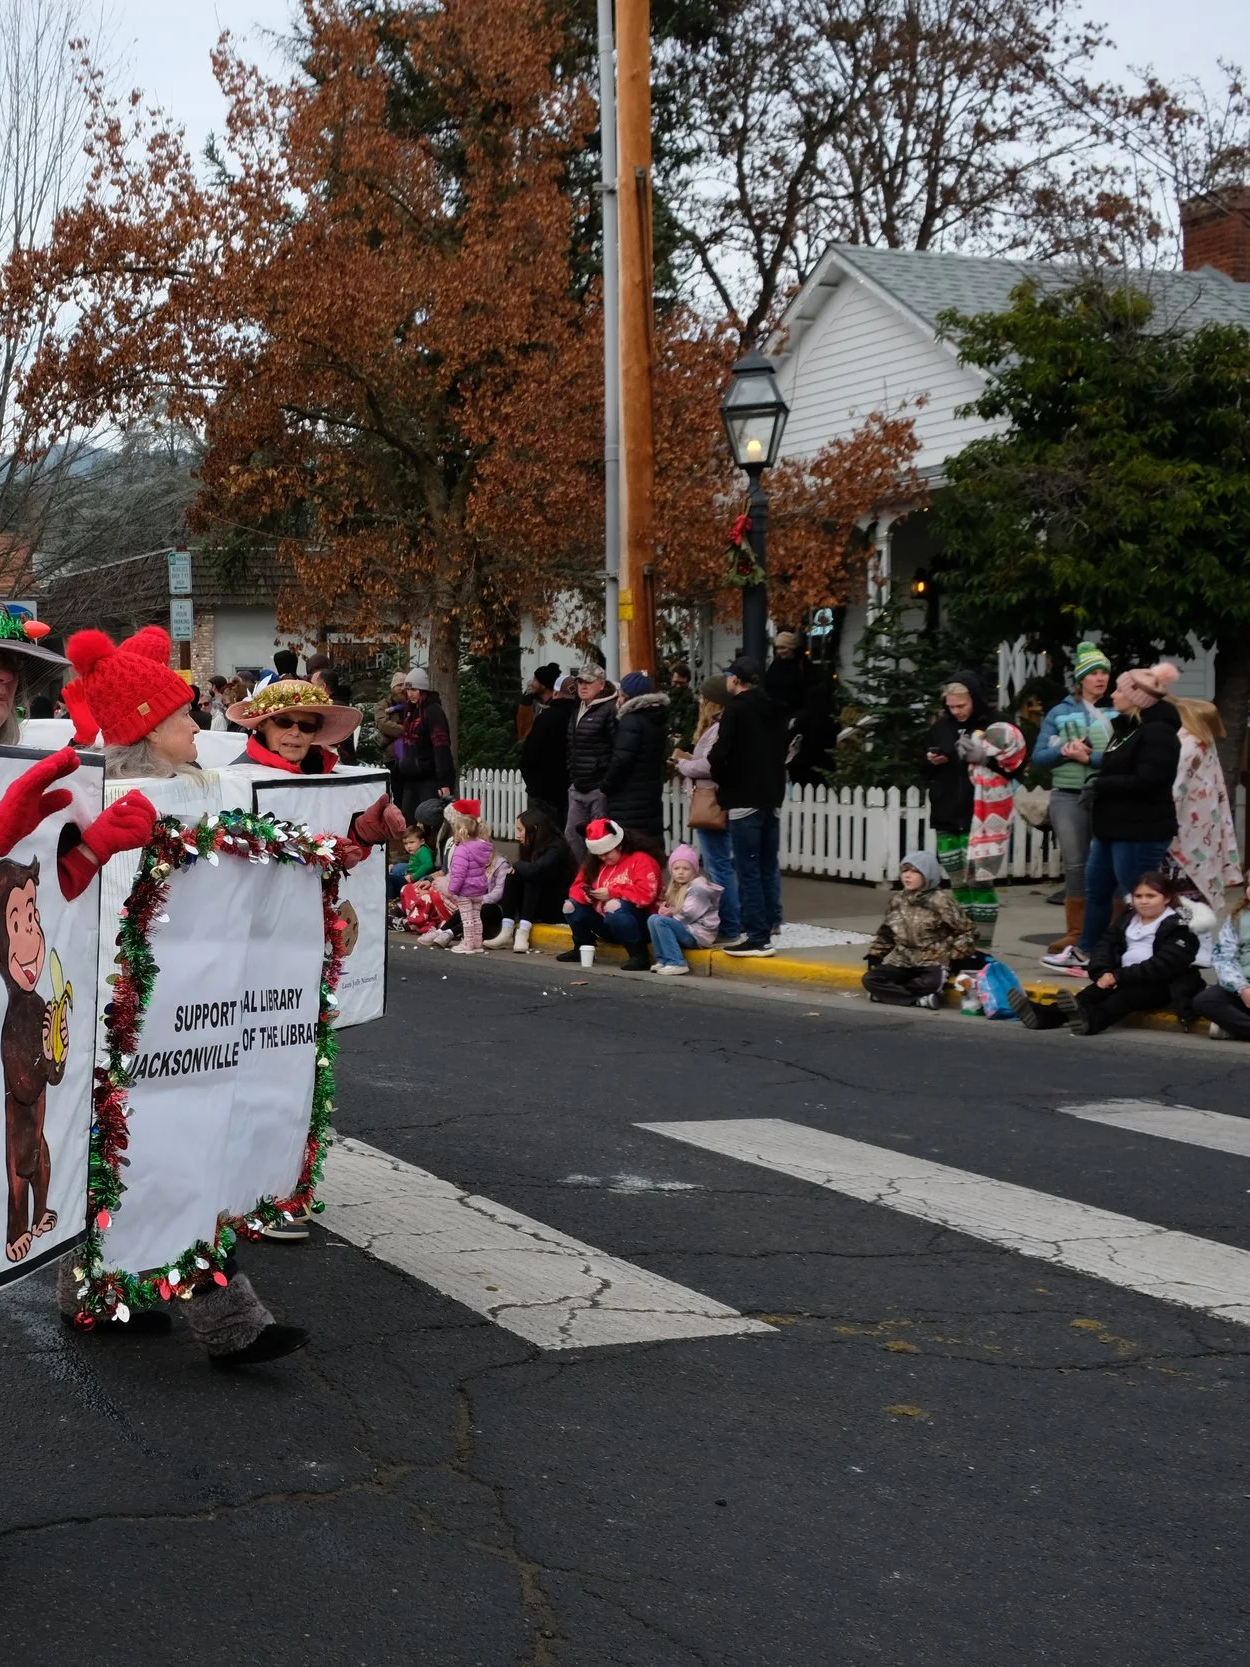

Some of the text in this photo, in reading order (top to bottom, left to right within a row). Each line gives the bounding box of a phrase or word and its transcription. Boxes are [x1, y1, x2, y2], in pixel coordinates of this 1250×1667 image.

[174, 1000, 238, 1033] SUPPORT
[260, 988, 303, 1013] LIBRARY
[129, 1041, 240, 1080] JACKSONVILLE
[242, 1027, 256, 1052] OF
[259, 1025, 278, 1050] THE
